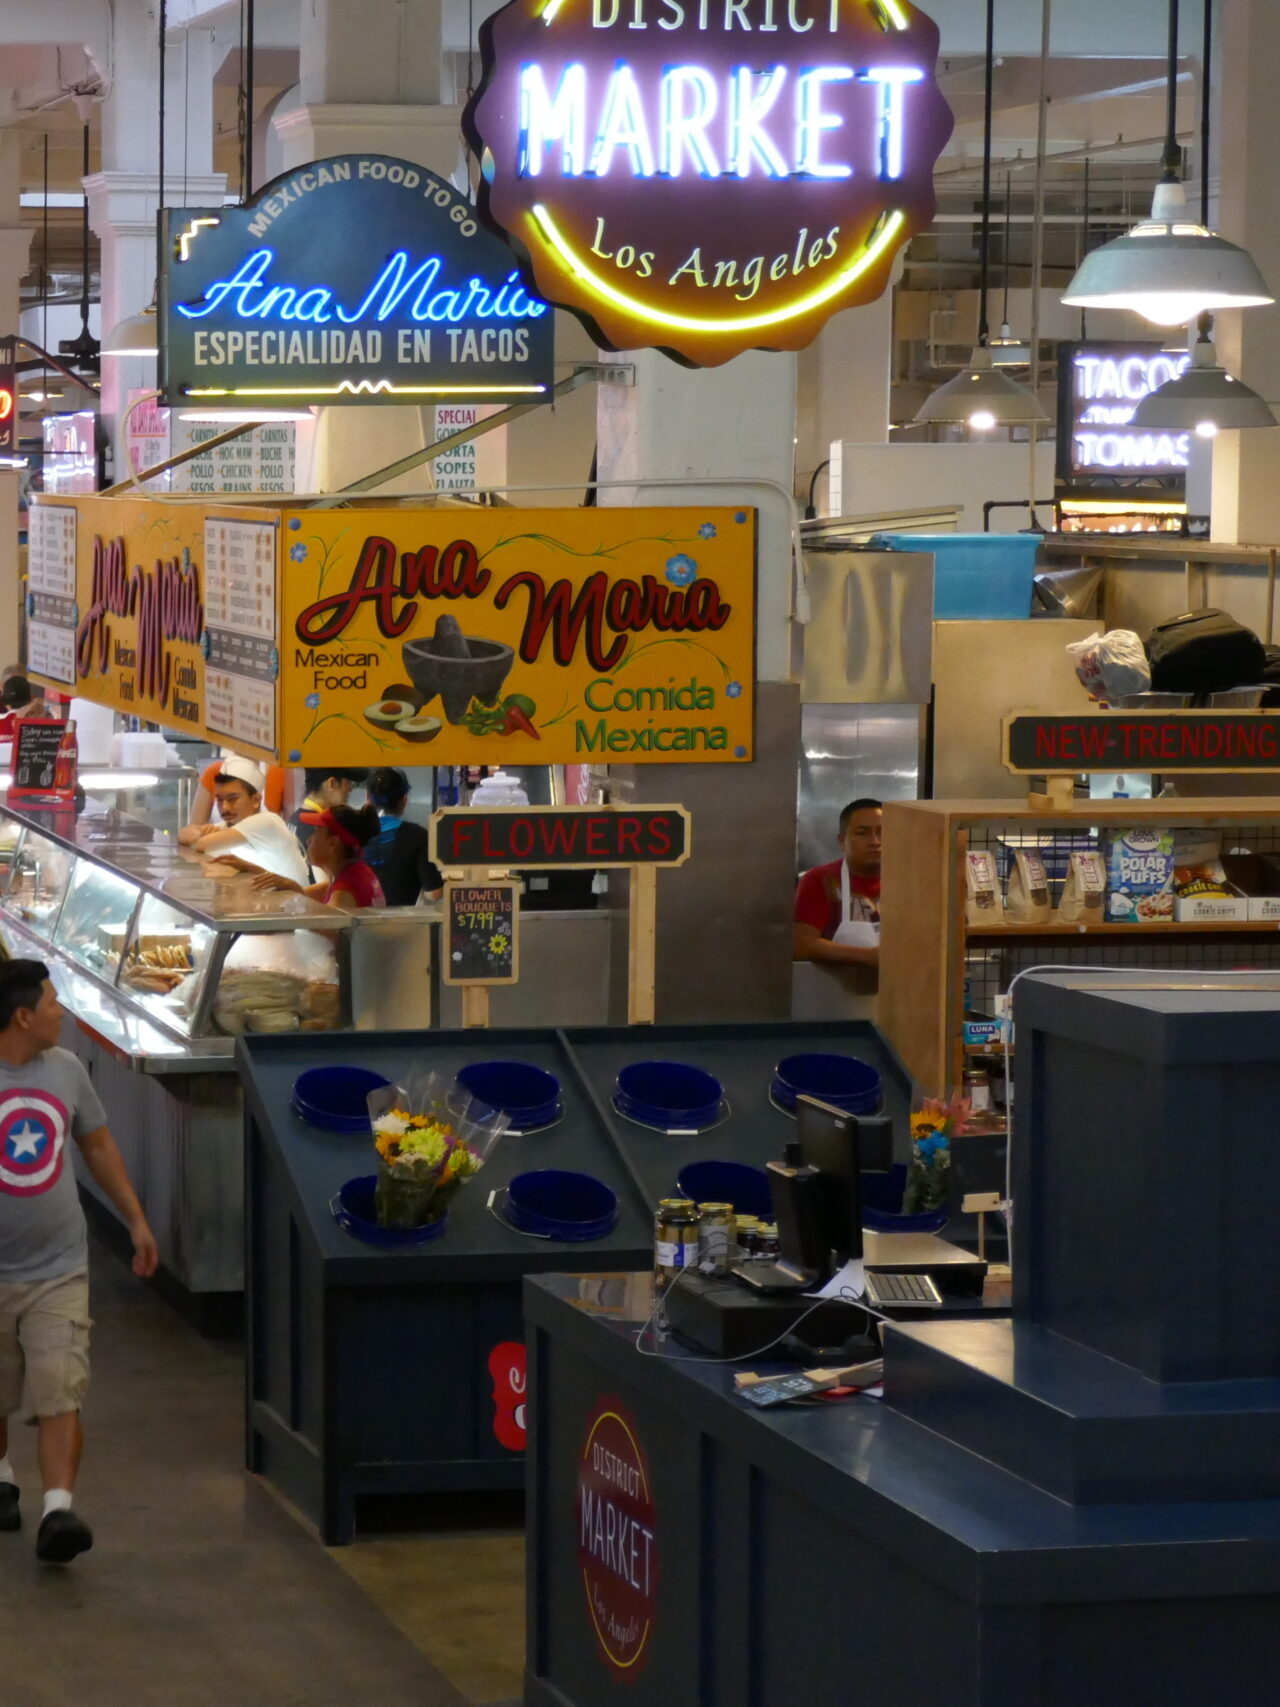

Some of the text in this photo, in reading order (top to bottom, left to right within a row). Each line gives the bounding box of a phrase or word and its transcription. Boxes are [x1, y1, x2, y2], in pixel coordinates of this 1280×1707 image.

[592, 0, 840, 33] DISTRICT
[520, 62, 923, 181] MARKET
[247, 161, 478, 239] MEXICAN FOOD TO GO
[592, 217, 840, 301] Los Angeles
[177, 250, 333, 324] Ana
[194, 328, 529, 366] ESPECIALIDAD EN TACOS
[1074, 434, 1190, 467] TOMAS
[190, 465, 253, 479] POLLO CHICKEN
[260, 465, 284, 479] POLLO
[436, 462, 475, 475] SOPES
[295, 535, 491, 647] Ana
[295, 648, 380, 669] Mexican
[313, 671, 367, 691] Food
[584, 676, 715, 713] Comida
[576, 719, 729, 753] Mexicana
[452, 817, 672, 857] FLOWERS
[1120, 857, 1167, 872] POLAR
[1122, 870, 1167, 885] PUFFS
[453, 889, 502, 902] FLOWER
[455, 902, 512, 913] BOUQUETS
[457, 912, 494, 930] $7.99
[971, 1025, 994, 1034] LUNA
[593, 1441, 640, 1500] DISTRICT
[581, 1484, 654, 1597] MARKET
